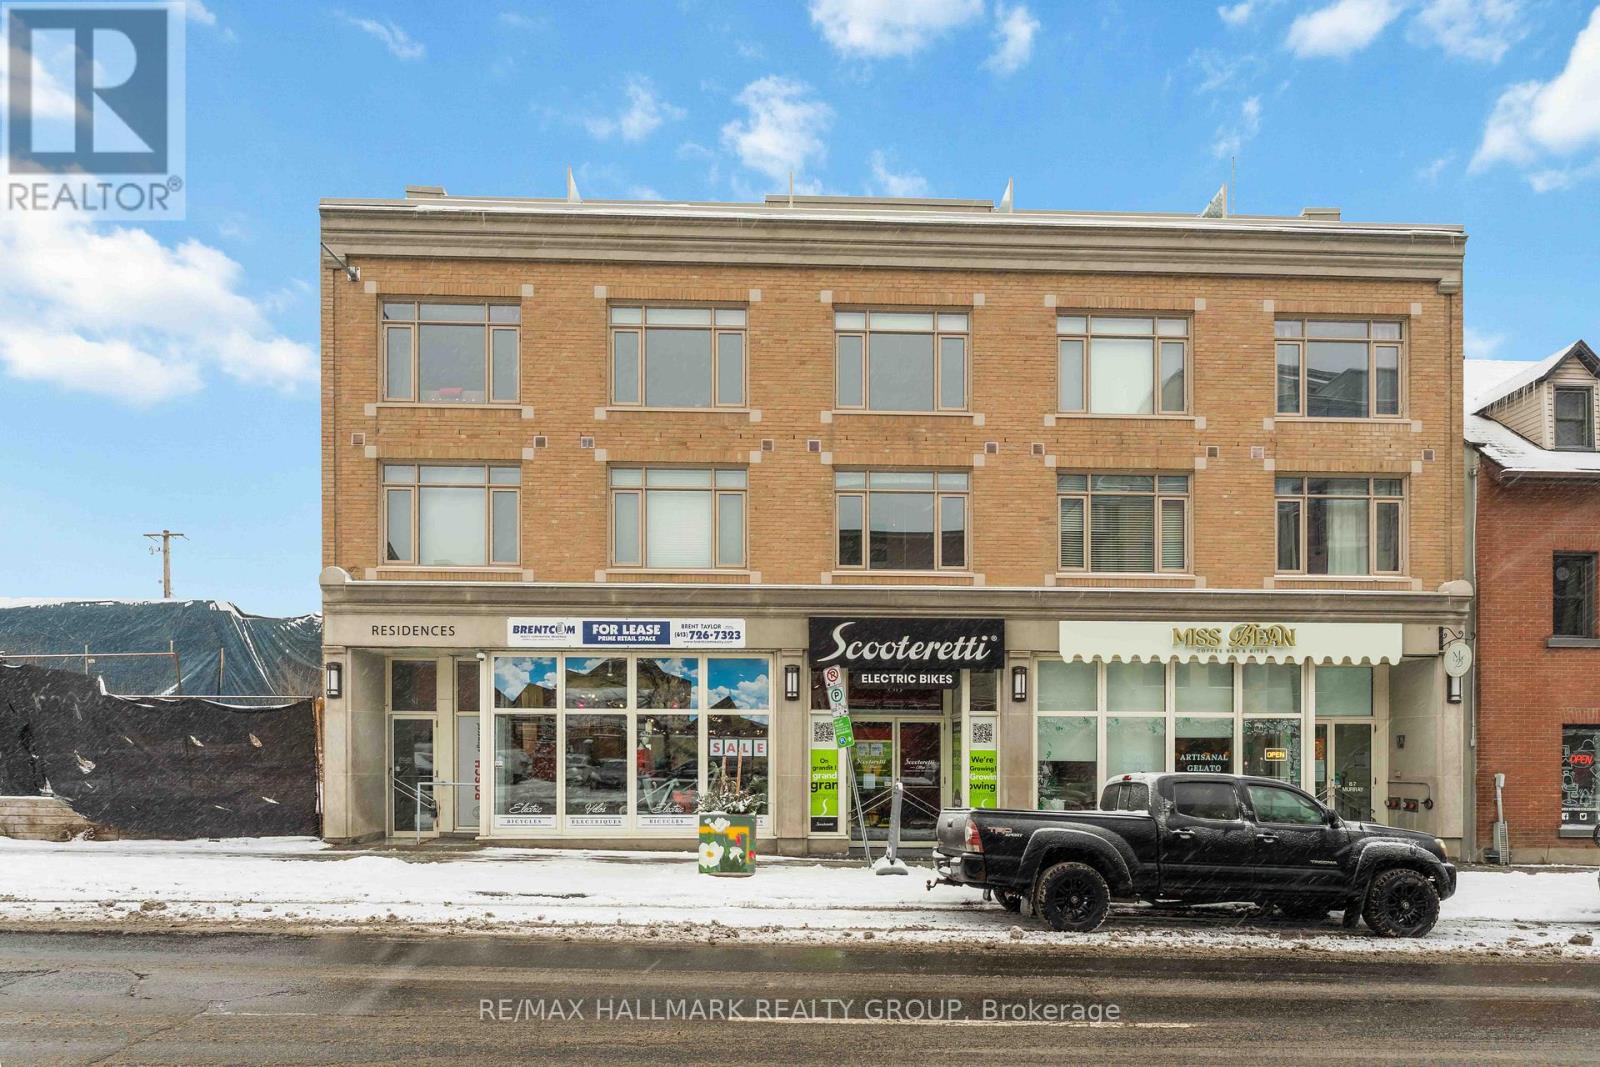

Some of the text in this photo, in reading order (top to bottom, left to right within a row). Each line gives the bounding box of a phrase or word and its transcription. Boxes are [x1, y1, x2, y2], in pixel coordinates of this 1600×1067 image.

[371, 625, 456, 636] RESIDENCES
[512, 622, 576, 635] BRENTCOM
[592, 624, 661, 635] FOR LEASE
[1172, 627, 1222, 647] MISS
[861, 674, 953, 684] ELECTRIC BIKES
[712, 742, 764, 753] SALE
[1266, 751, 1285, 759] OPEN
[1570, 755, 1593, 764] OPEN
[508, 801, 543, 814] Electric
